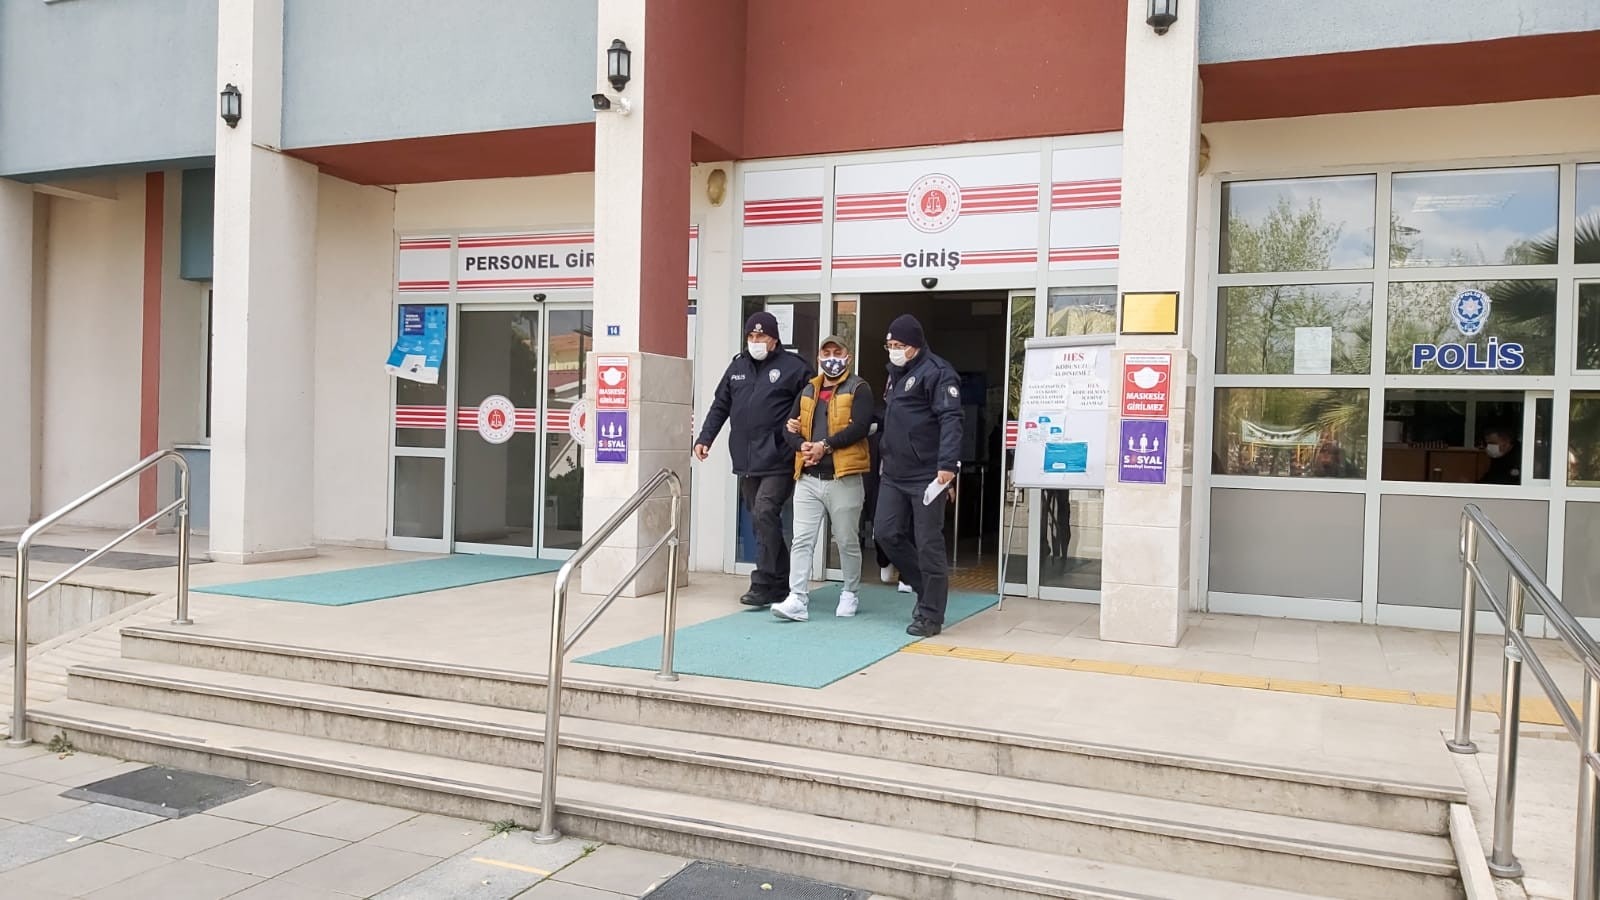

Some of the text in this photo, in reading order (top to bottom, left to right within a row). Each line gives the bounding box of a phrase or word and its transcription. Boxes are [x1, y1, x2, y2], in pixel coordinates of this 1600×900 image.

[465, 253, 560, 271] PERSONEL
[903, 248, 960, 270] GİRİŞ
[1412, 336, 1525, 370] POLİS
[1126, 391, 1166, 400] MASKESİZ
[1126, 401, 1165, 411] GİRİLMEZ
